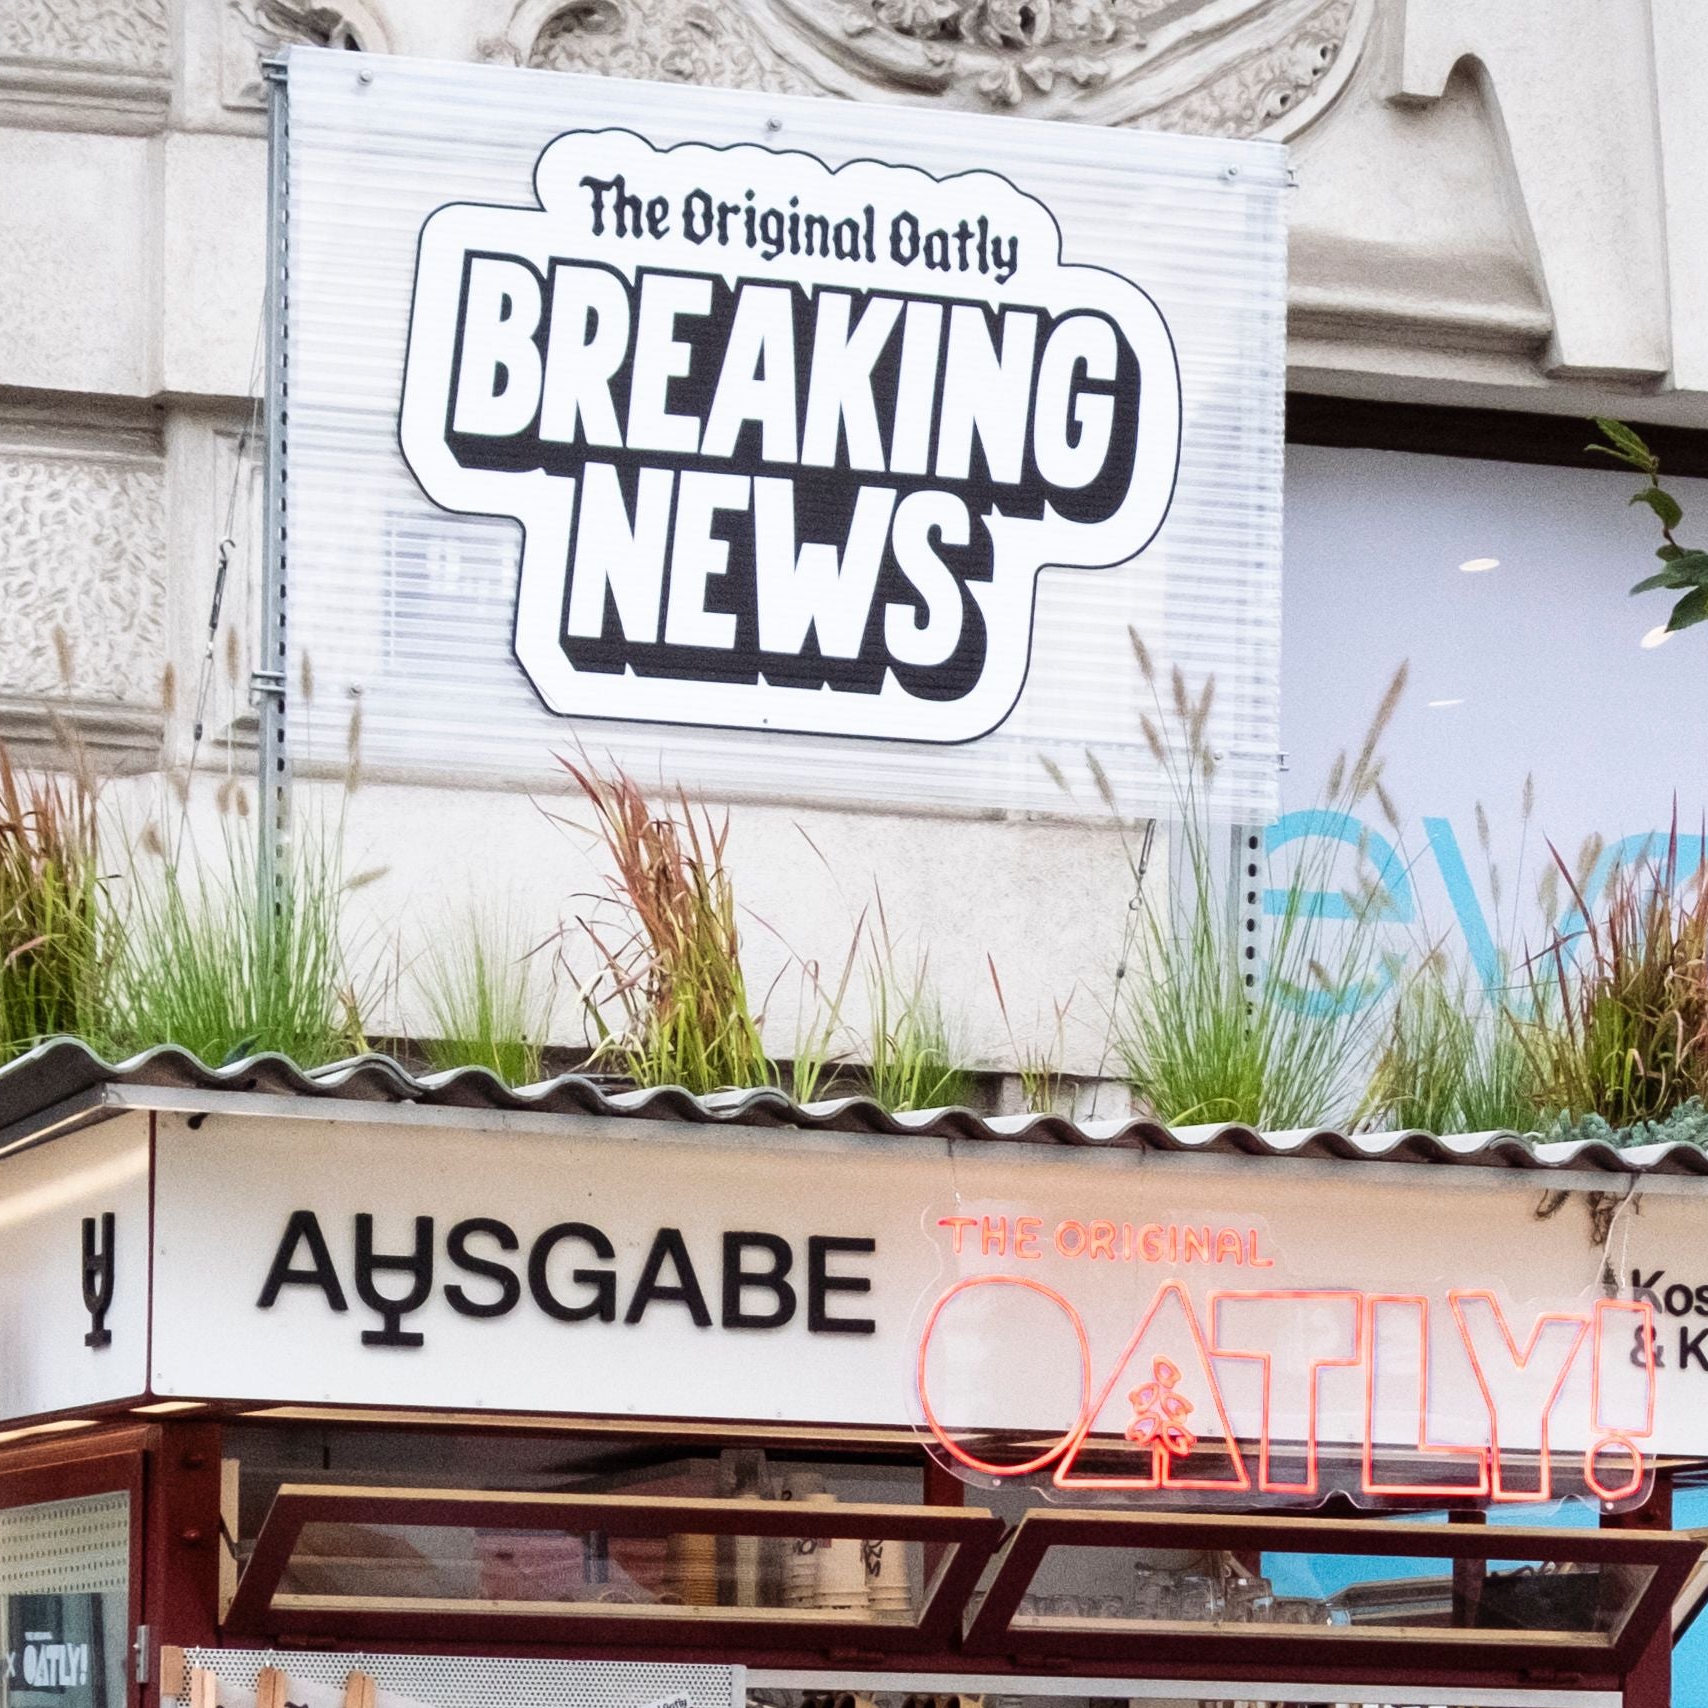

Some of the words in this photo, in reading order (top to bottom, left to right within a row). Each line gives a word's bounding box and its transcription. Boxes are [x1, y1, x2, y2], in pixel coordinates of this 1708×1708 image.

[579, 174, 671, 243] The
[682, 184, 877, 265] Original
[888, 208, 1020, 285] Oatly
[448, 250, 1132, 512] BREAKING
[561, 459, 983, 692] NEWS
[938, 1214, 1044, 1259] THE
[1054, 1218, 1274, 1269] ORIGINAL
[917, 1274, 1655, 1501] OATLY!
[1630, 1327, 1668, 1370] &
[23, 1643, 88, 1686] OATLY!
